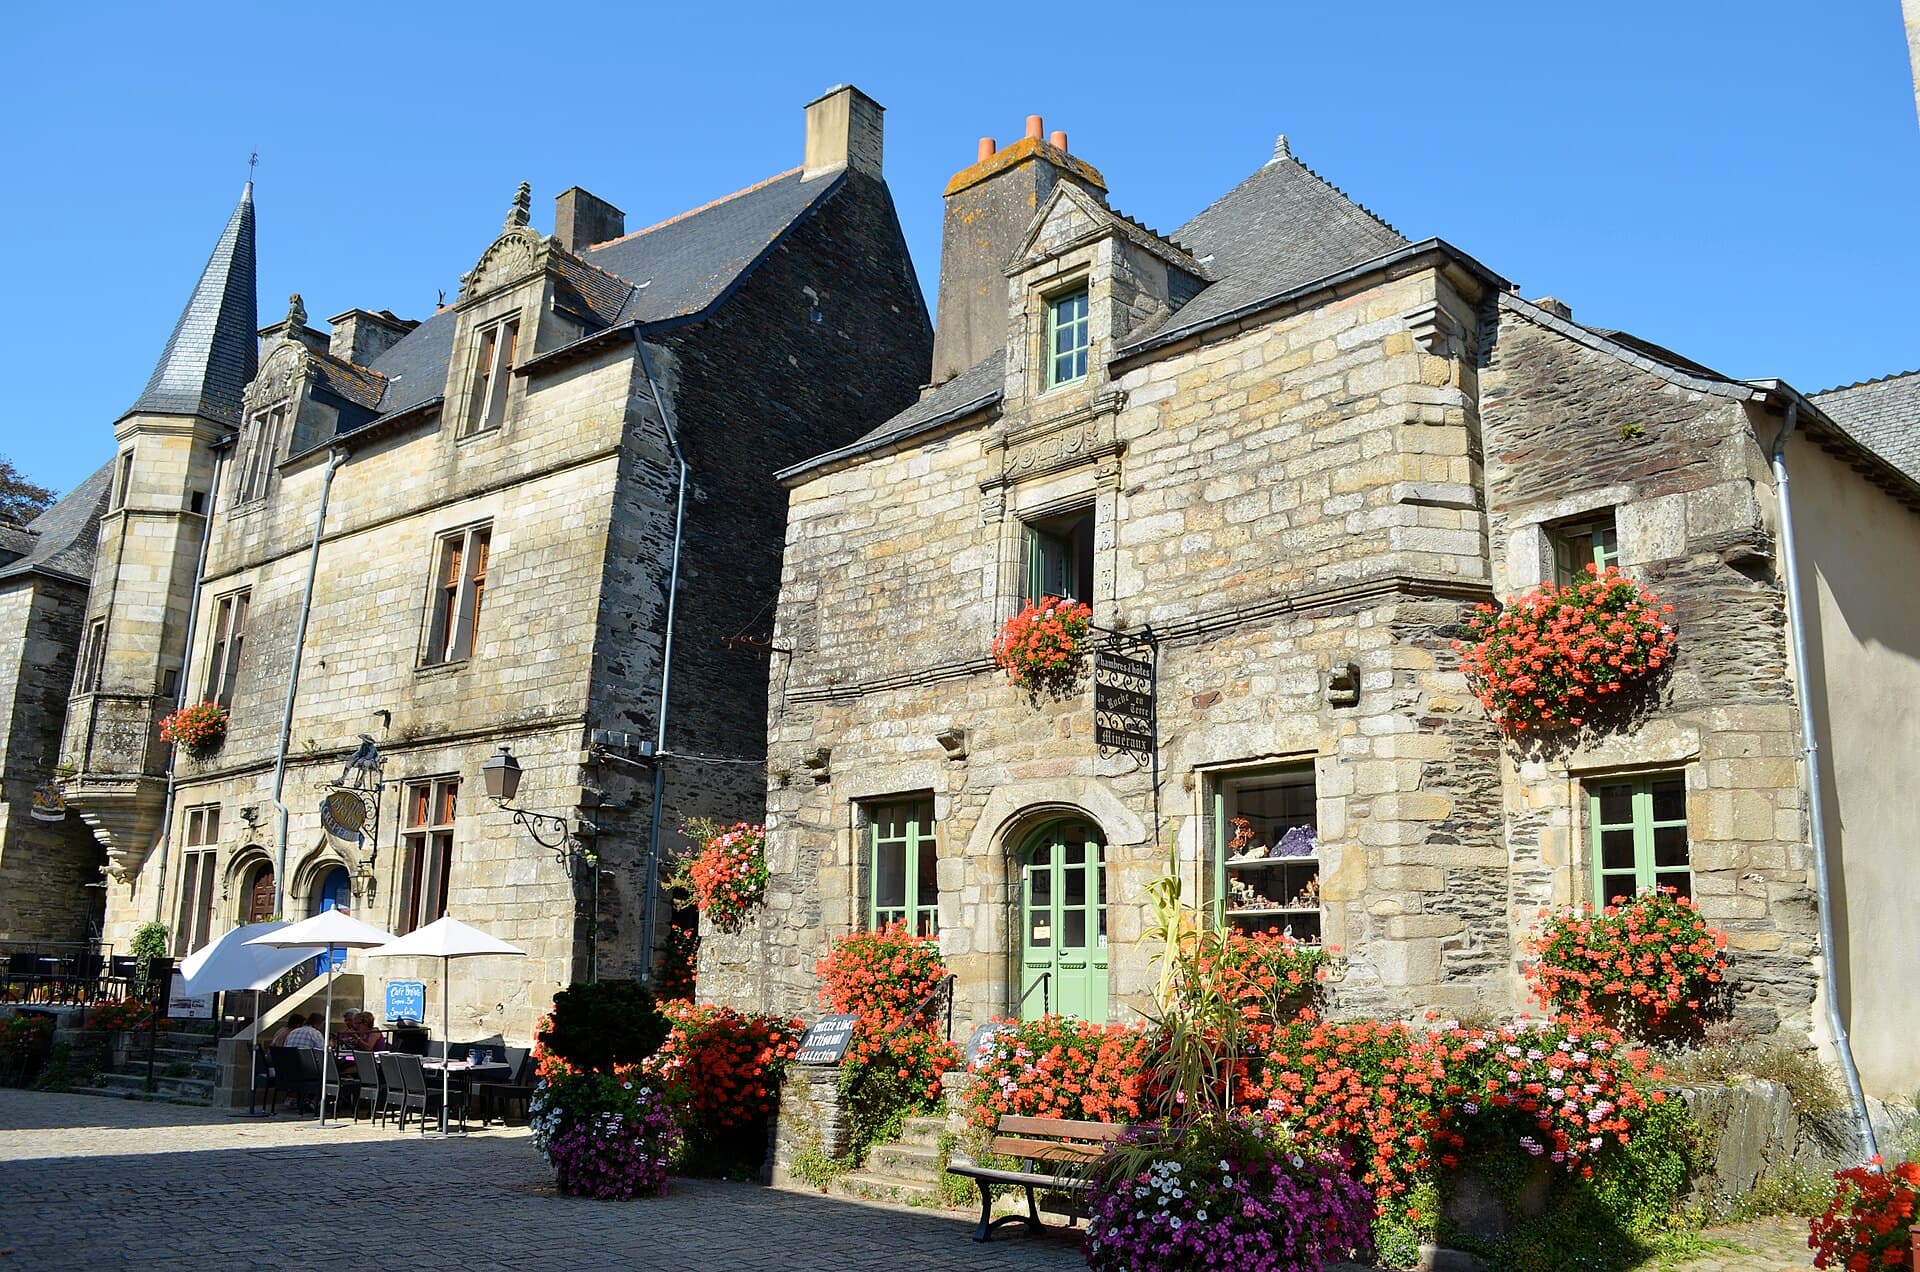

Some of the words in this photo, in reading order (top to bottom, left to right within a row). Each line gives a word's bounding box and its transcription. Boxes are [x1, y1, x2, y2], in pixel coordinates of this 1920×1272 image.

[1096, 653, 1127, 673] Chambres
[1135, 697, 1144, 705] en
[1129, 703, 1149, 717] Terre
[1102, 729, 1147, 751] Minéraux
